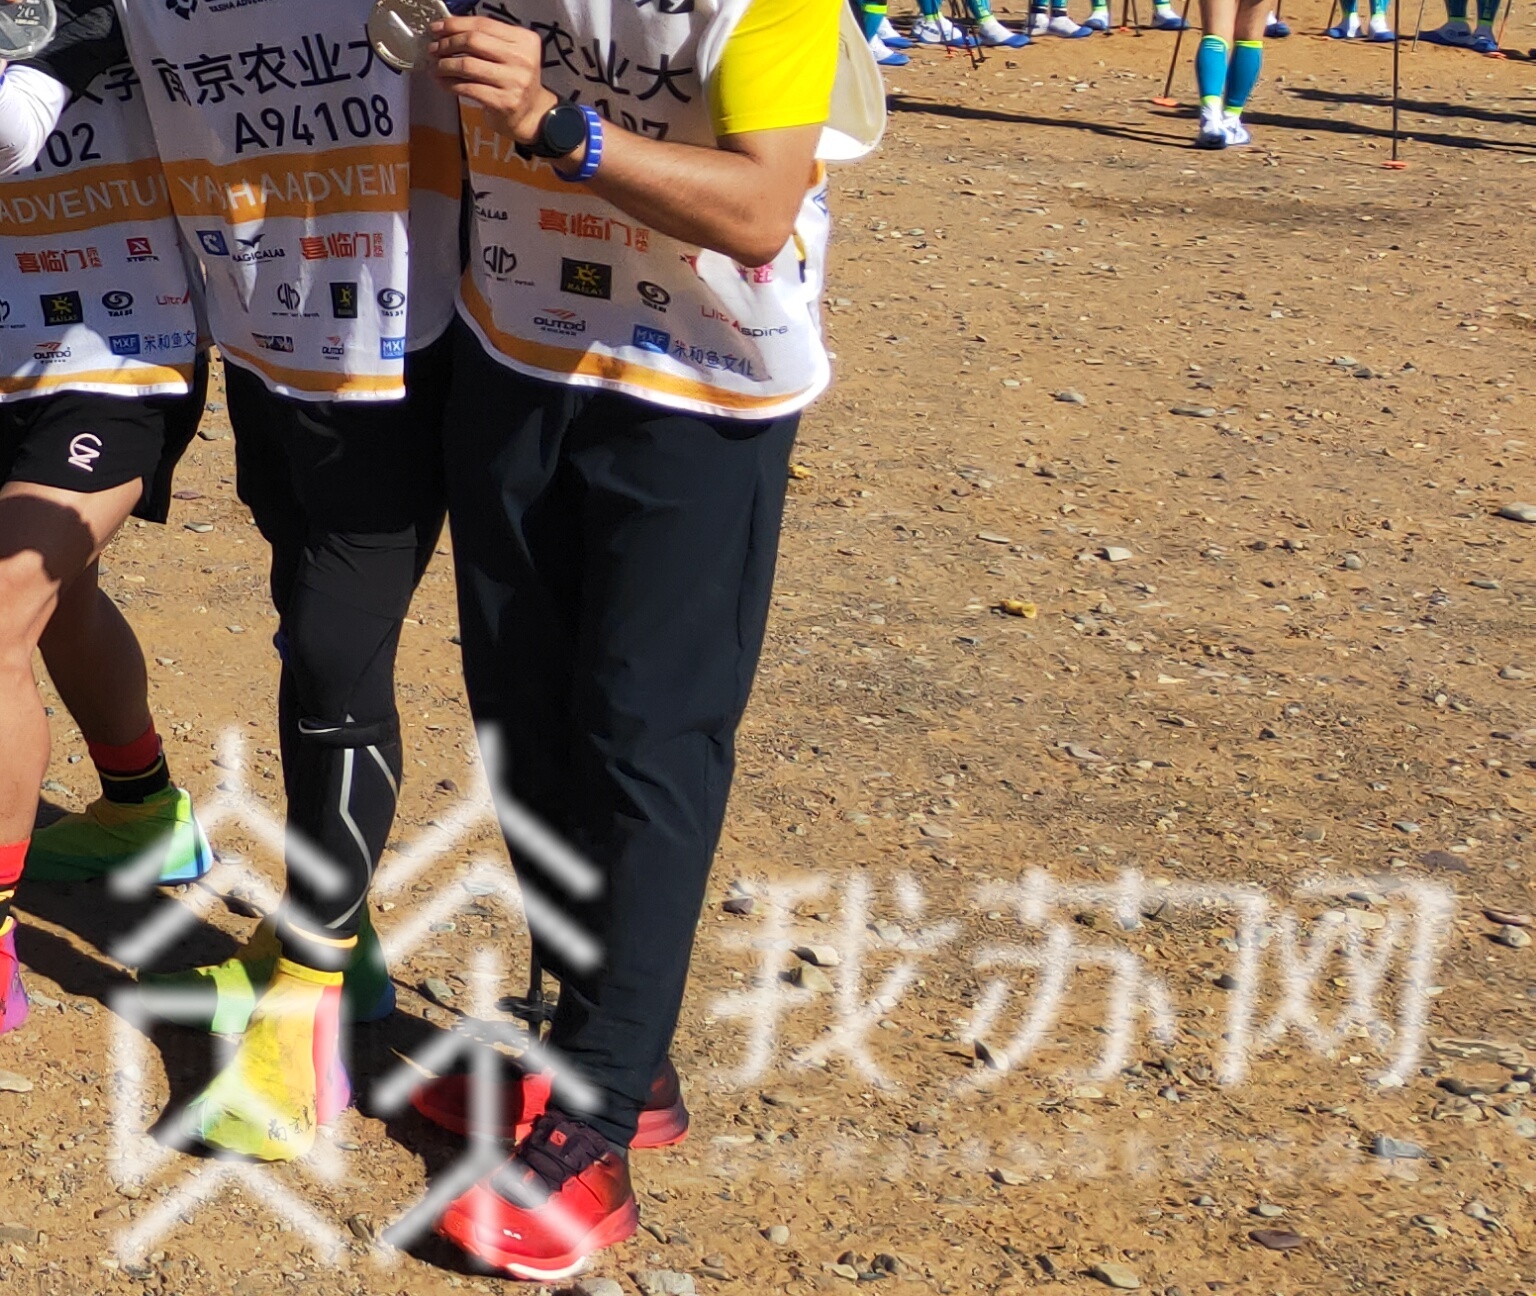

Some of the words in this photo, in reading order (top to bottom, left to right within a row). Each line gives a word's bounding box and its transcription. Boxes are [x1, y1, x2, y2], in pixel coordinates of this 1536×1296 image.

[235, 93, 394, 154] A94108
[539, 207, 634, 248] 喜临门
[299, 232, 371, 261] 喜临门
[15, 249, 87, 274] 喜临门
[113, 337, 137, 348] MXF
[636, 330, 667, 350] MXF
[674, 339, 755, 378] 米和鱼文化
